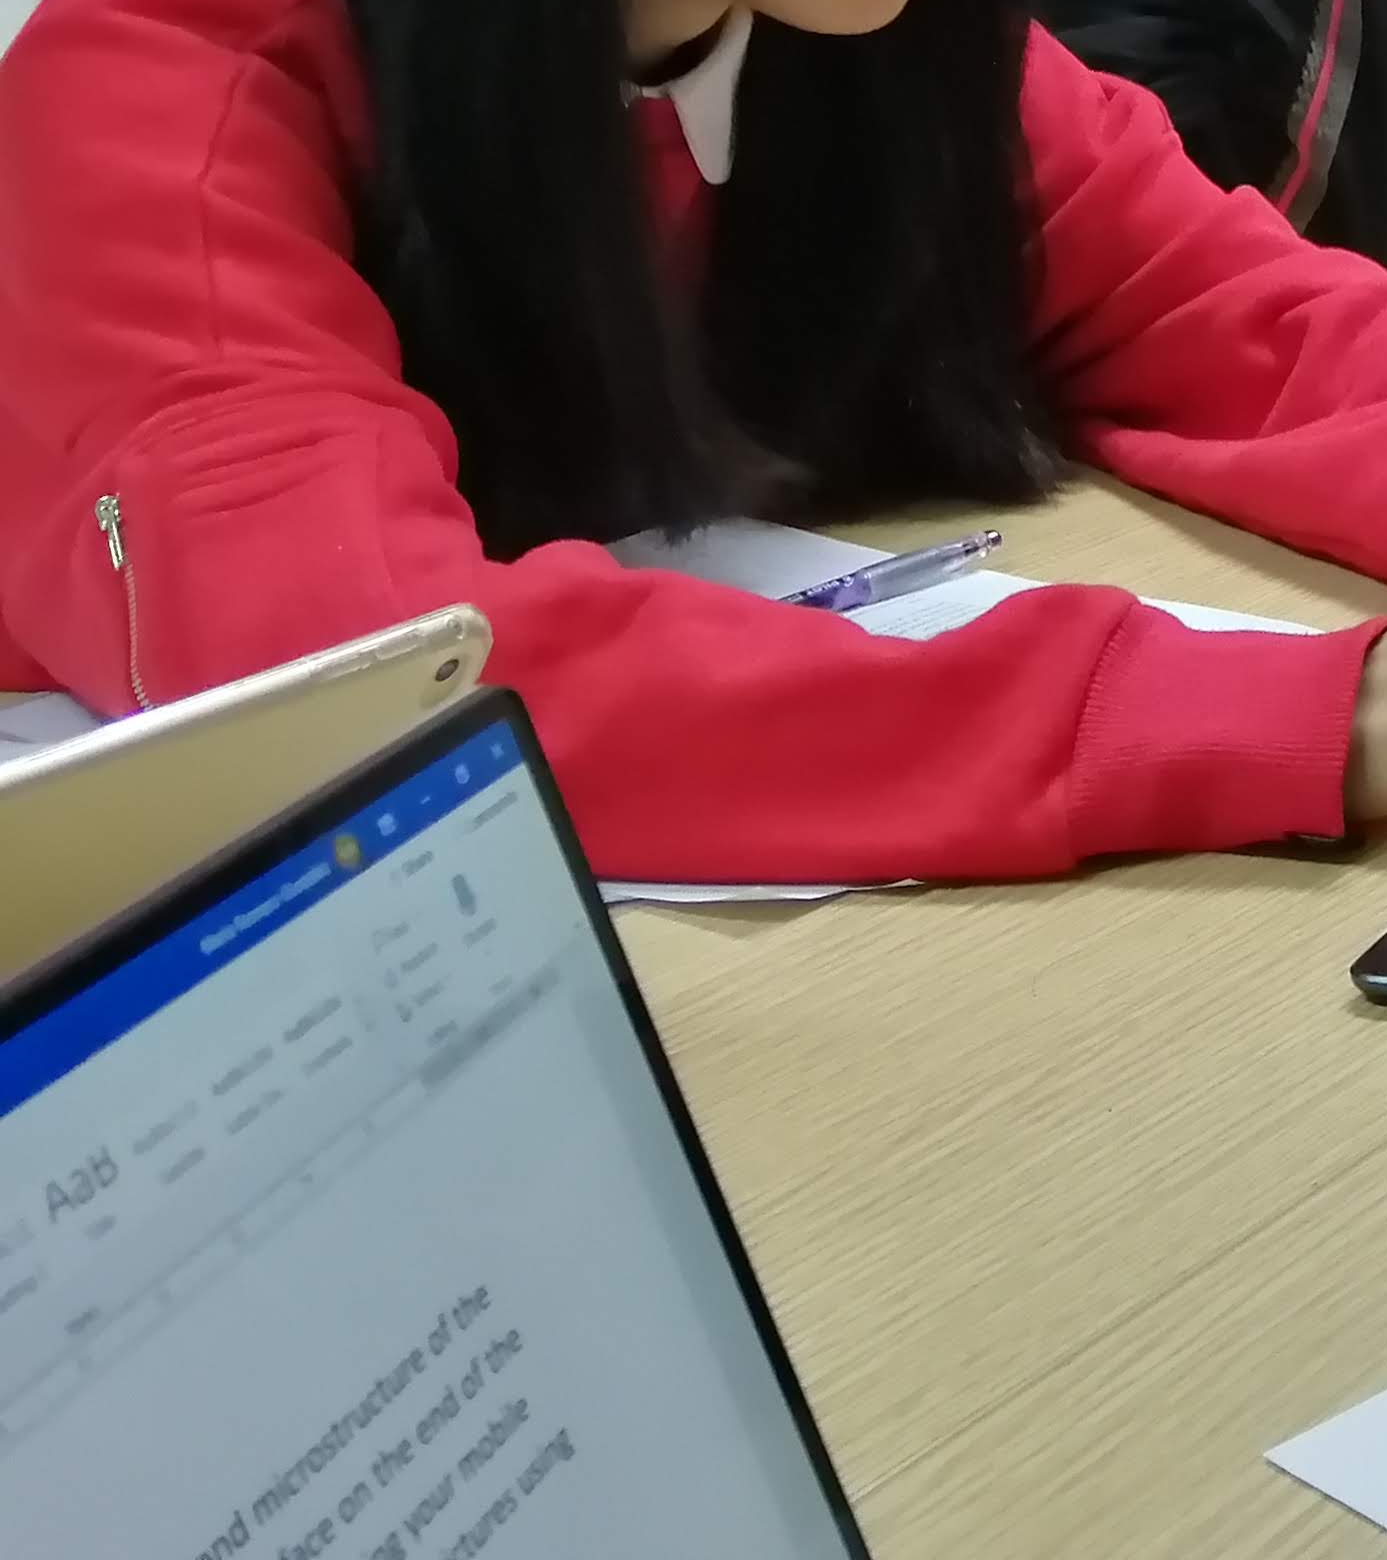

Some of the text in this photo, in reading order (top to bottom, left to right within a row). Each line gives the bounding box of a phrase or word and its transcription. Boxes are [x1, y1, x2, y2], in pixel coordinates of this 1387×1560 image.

[252, 1347, 427, 1525] microstructure
[428, 1313, 452, 1356] of
[453, 1285, 492, 1330] the
[338, 1481, 373, 1524] on
[373, 1439, 415, 1487] the
[416, 1384, 461, 1445] end
[461, 1356, 485, 1400] of
[484, 1329, 522, 1374] the
[404, 1473, 455, 1541] your
[457, 1397, 529, 1482] mobile
